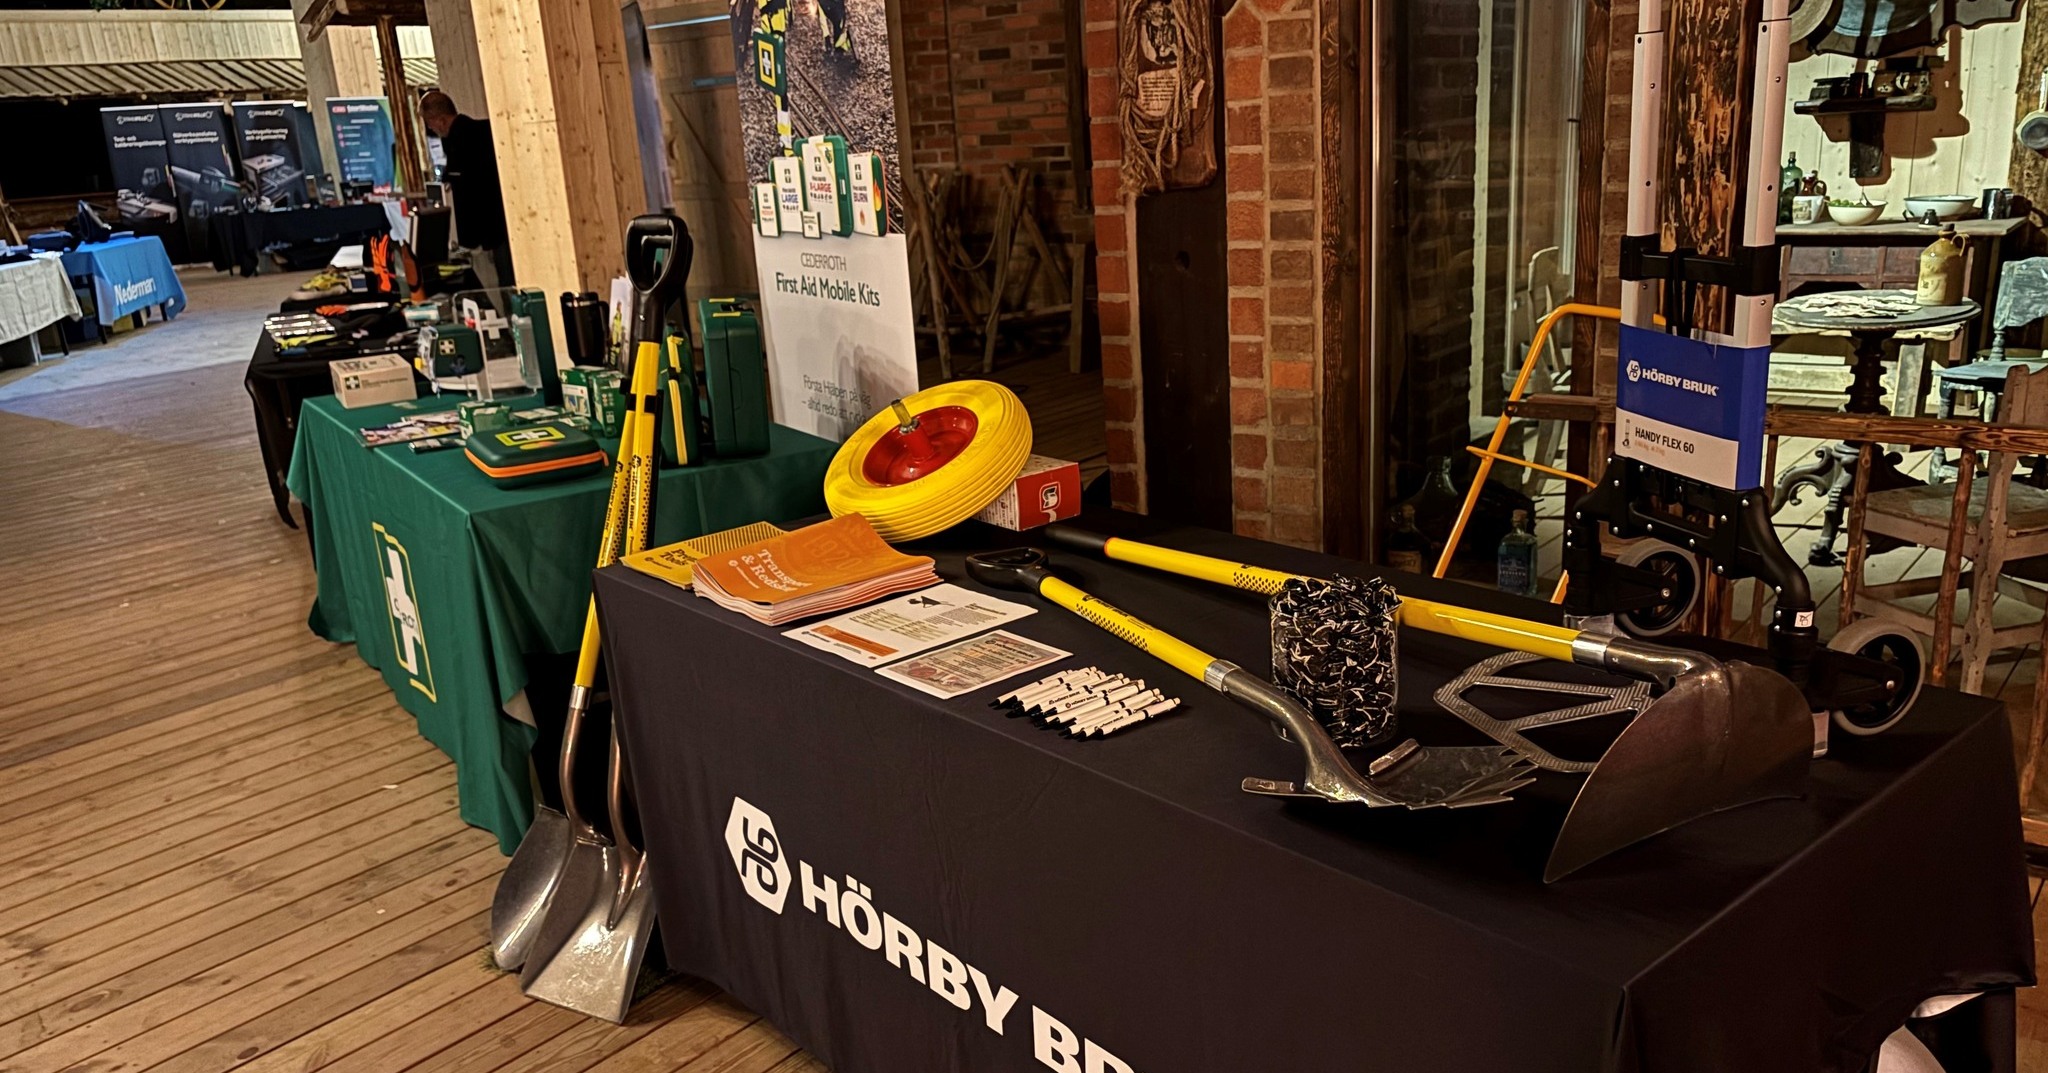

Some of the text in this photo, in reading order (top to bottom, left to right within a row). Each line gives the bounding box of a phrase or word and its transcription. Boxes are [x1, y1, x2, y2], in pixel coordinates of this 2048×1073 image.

[781, 193, 799, 204] LARGE
[853, 192, 868, 203] BURN
[800, 252, 847, 271] CEDERROTH
[113, 277, 157, 306] Nederman
[776, 272, 880, 306] First Aid Mobile Kits
[1642, 368, 1718, 397] HÖRBY BRUK
[1635, 426, 1661, 444] HANDY
[1662, 435, 1682, 451] FLEX
[1683, 441, 1695, 454] 60
[741, 555, 755, 566] &
[799, 859, 1019, 1036] HÖRBY
